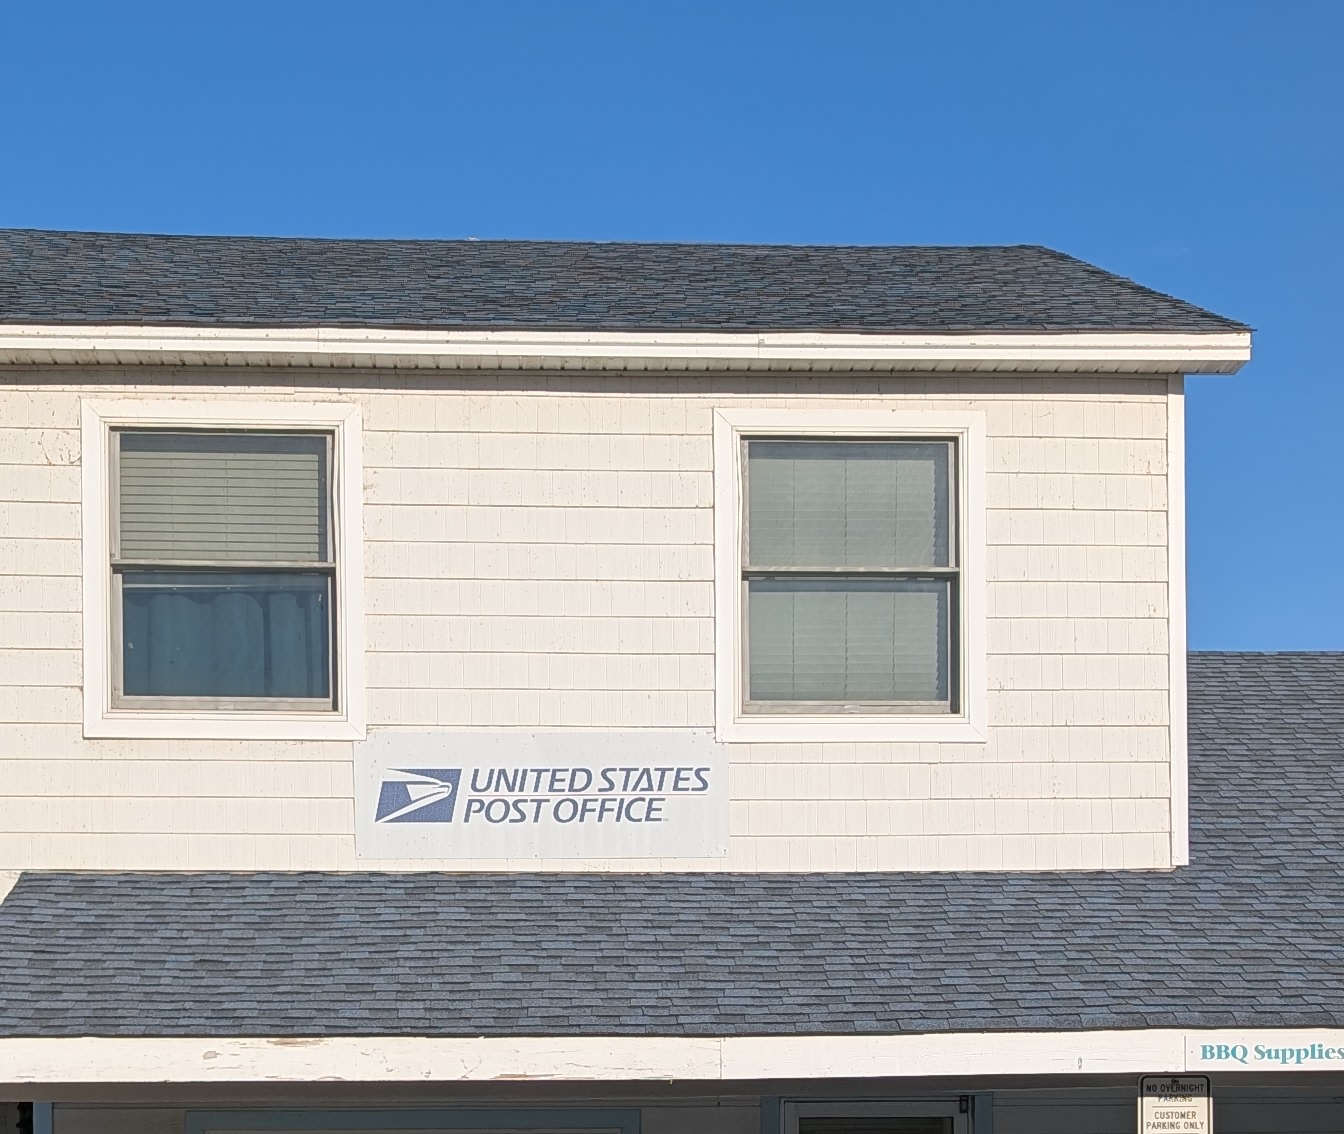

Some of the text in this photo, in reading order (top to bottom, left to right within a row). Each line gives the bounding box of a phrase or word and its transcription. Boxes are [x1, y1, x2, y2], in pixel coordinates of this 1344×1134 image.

[470, 767, 710, 793] UNITED STATES
[463, 797, 666, 823] POST OFFICE
[1200, 1044, 1249, 1064] BBQ
[1146, 1084, 1204, 1092] NO OVERNIGHT
[1158, 1094, 1192, 1102] PARKING
[1155, 1111, 1196, 1120] CUSTOMER
[1146, 1121, 1204, 1130] PARKING ONLY
